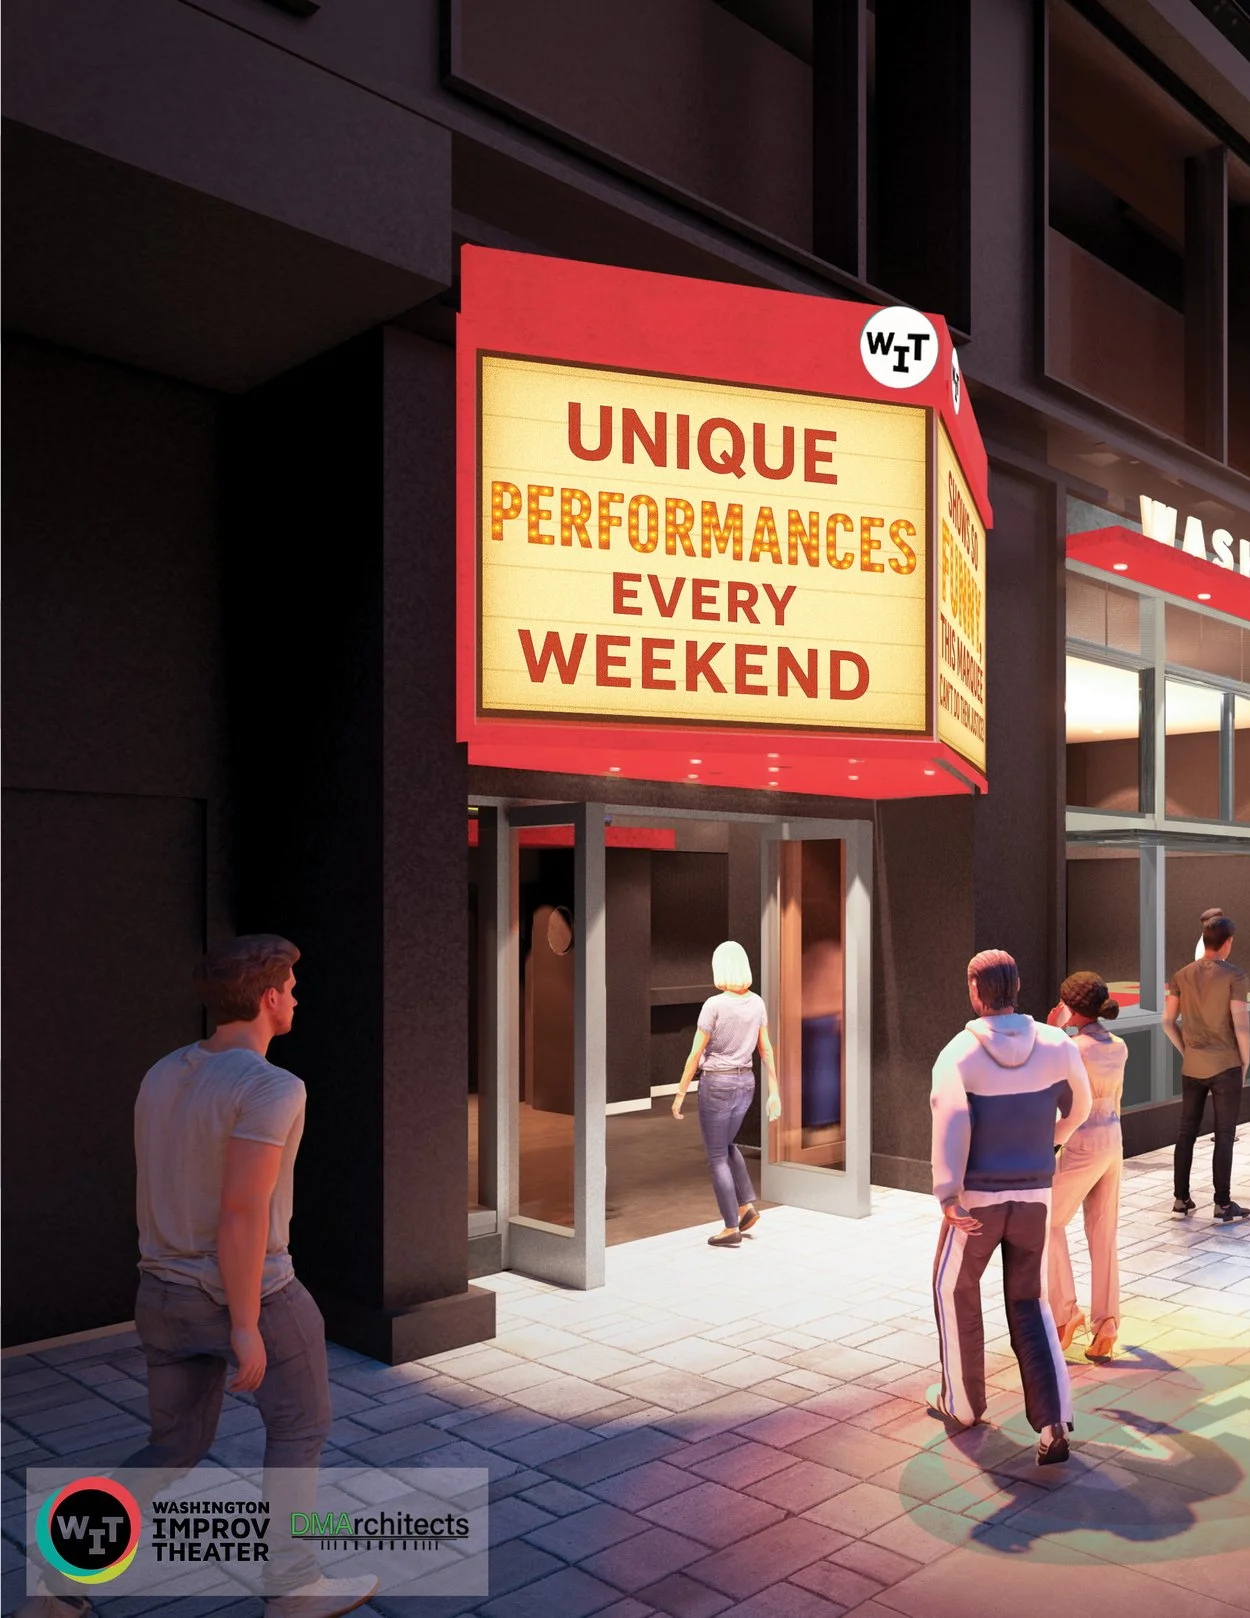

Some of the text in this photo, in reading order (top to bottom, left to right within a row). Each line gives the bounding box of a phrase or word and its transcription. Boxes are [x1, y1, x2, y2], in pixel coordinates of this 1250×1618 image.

[867, 331, 930, 374] WIT
[567, 401, 838, 486] UNIQUE
[490, 480, 917, 575] PERFORMANCES
[948, 469, 979, 572] SHOWS SO
[612, 571, 797, 626] EVERY
[518, 628, 870, 700] WEEKEND
[940, 611, 983, 705] THIS MARQUEE
